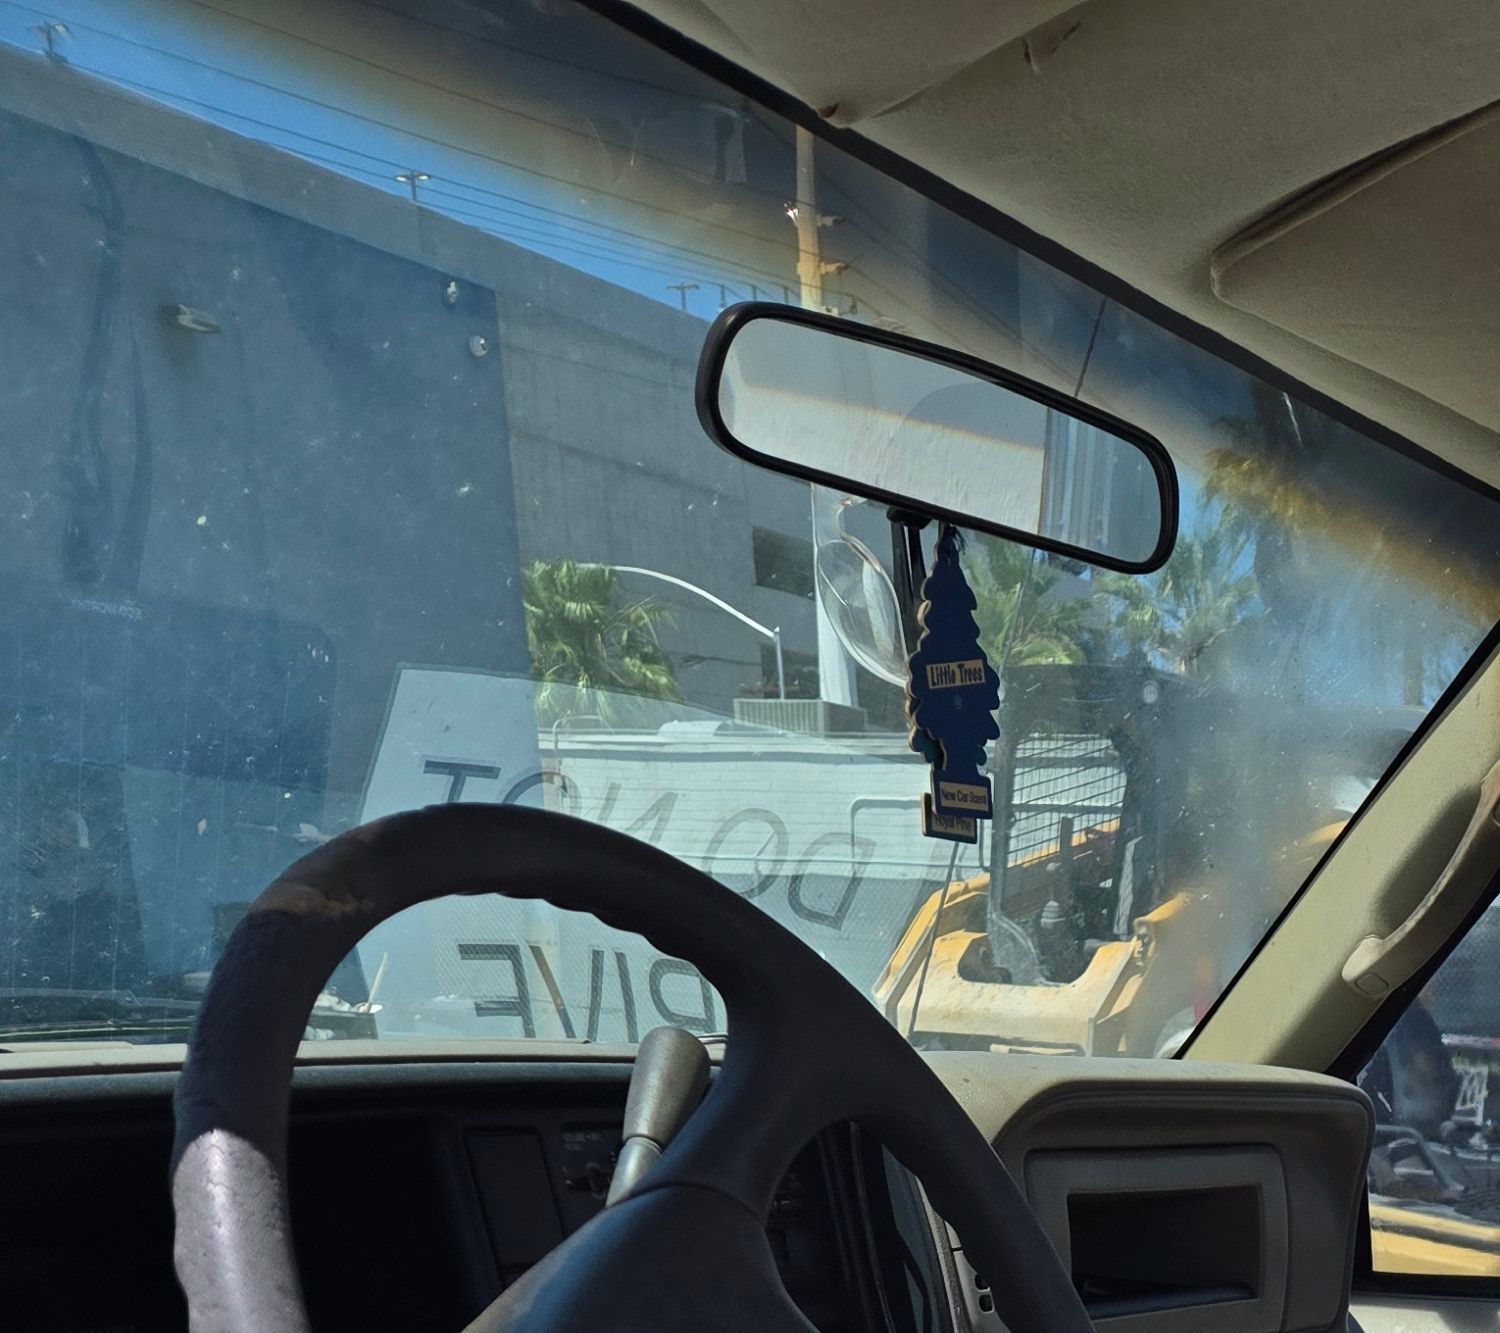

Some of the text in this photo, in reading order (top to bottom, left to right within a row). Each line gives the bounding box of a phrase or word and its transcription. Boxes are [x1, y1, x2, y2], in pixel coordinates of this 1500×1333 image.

[930, 662, 983, 687] Little Trees
[941, 786, 956, 802] New
[957, 788, 969, 804] Car
